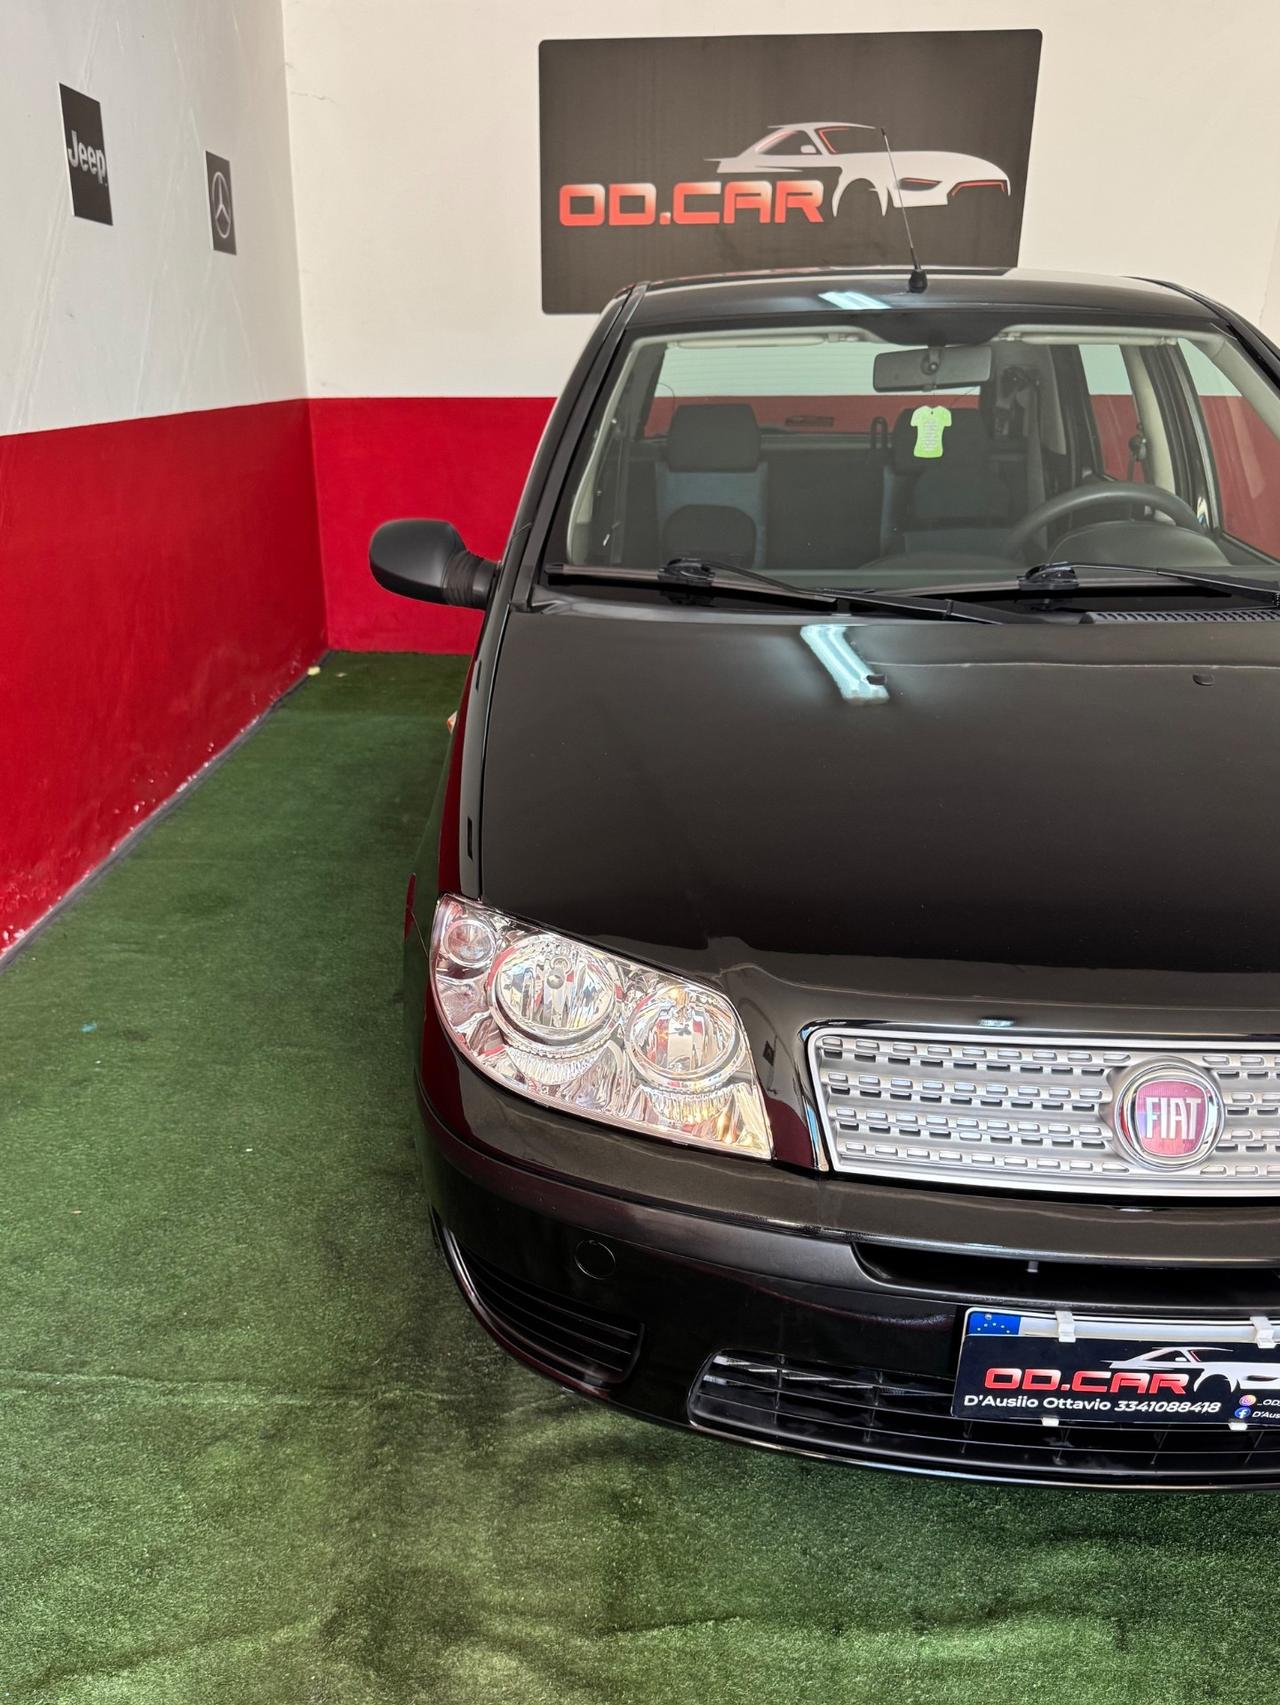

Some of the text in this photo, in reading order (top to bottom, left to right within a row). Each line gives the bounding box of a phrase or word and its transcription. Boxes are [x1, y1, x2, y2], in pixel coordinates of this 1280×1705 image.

[67, 129, 106, 184] Jeep
[558, 181, 824, 226] OD.CAR
[1145, 1097, 1201, 1140] FIAT
[984, 1368, 1190, 1395] OD.CAR
[1042, 1396, 1111, 1411] Ottavio
[1114, 1400, 1221, 1413] 3341088418
